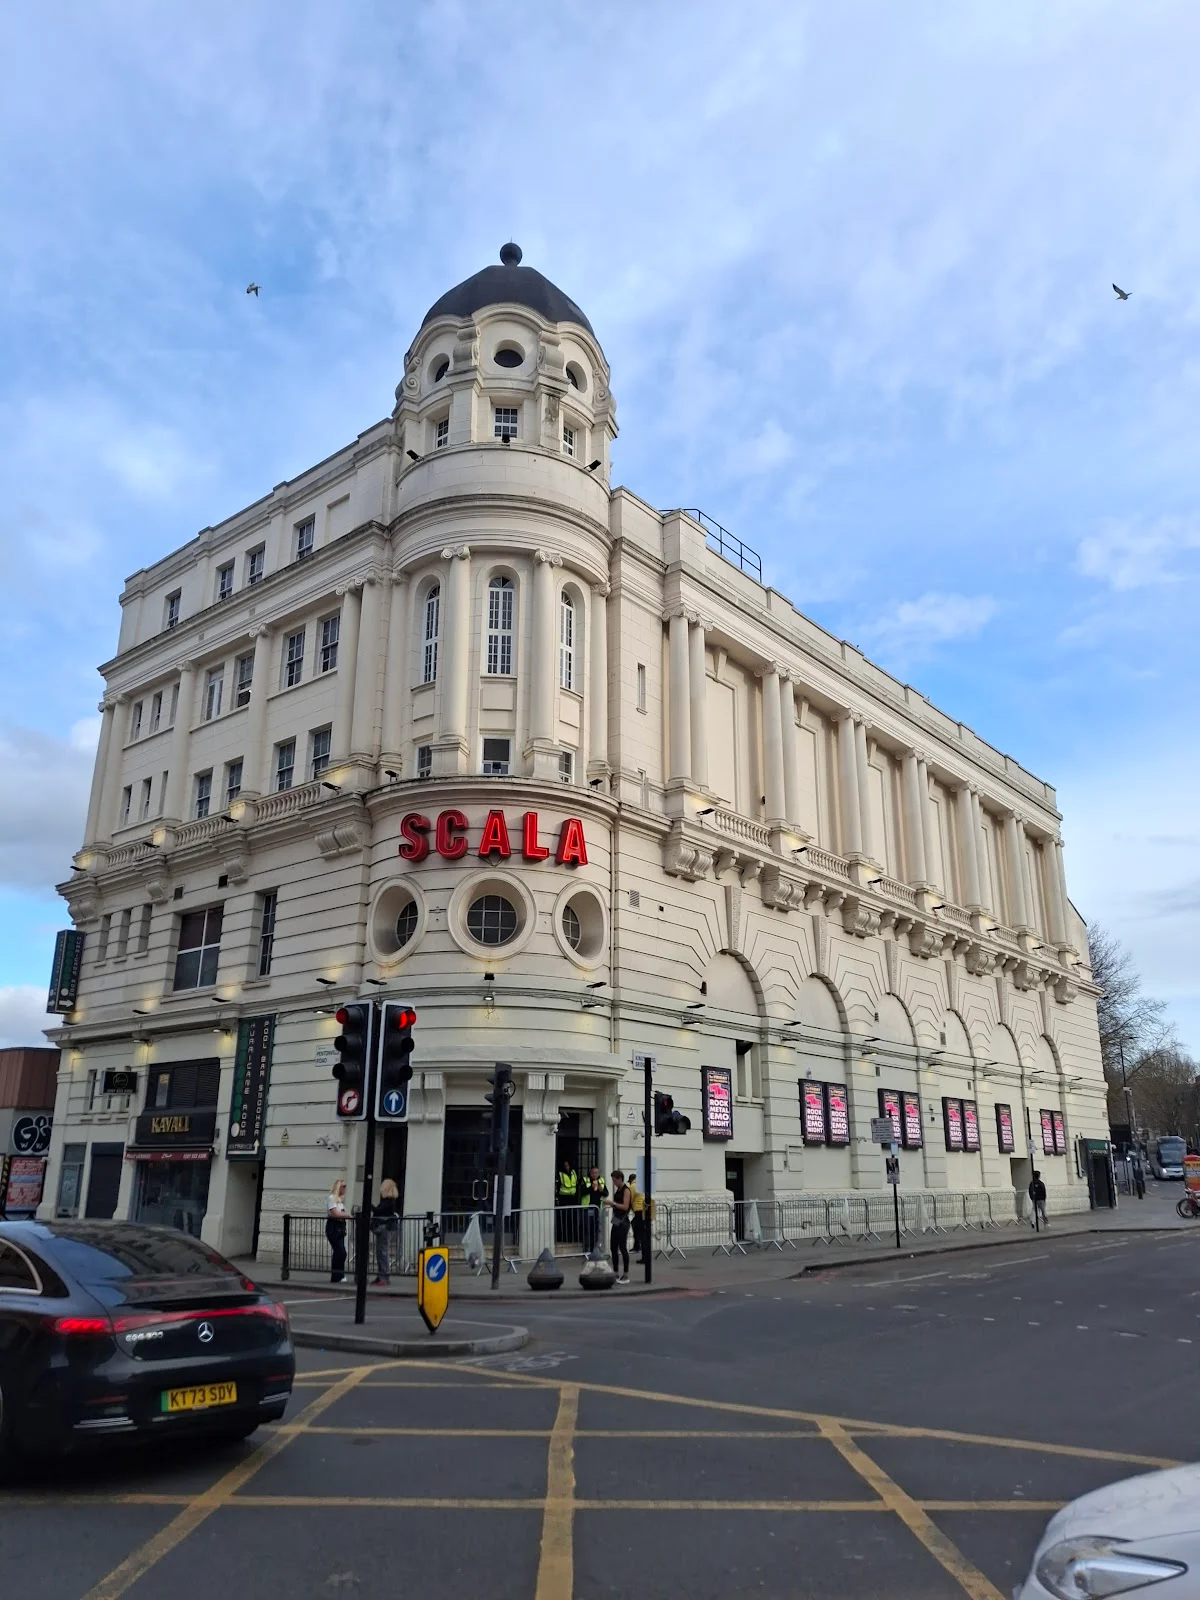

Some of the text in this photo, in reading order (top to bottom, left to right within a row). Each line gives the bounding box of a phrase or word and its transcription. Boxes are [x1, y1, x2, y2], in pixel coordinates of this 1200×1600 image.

[399, 810, 589, 867] SCALA
[240, 1022, 255, 1137] HURRICANE ROOM
[254, 1085, 264, 1136] SNOOKER
[170, 1384, 234, 1408] KT73 SDY
